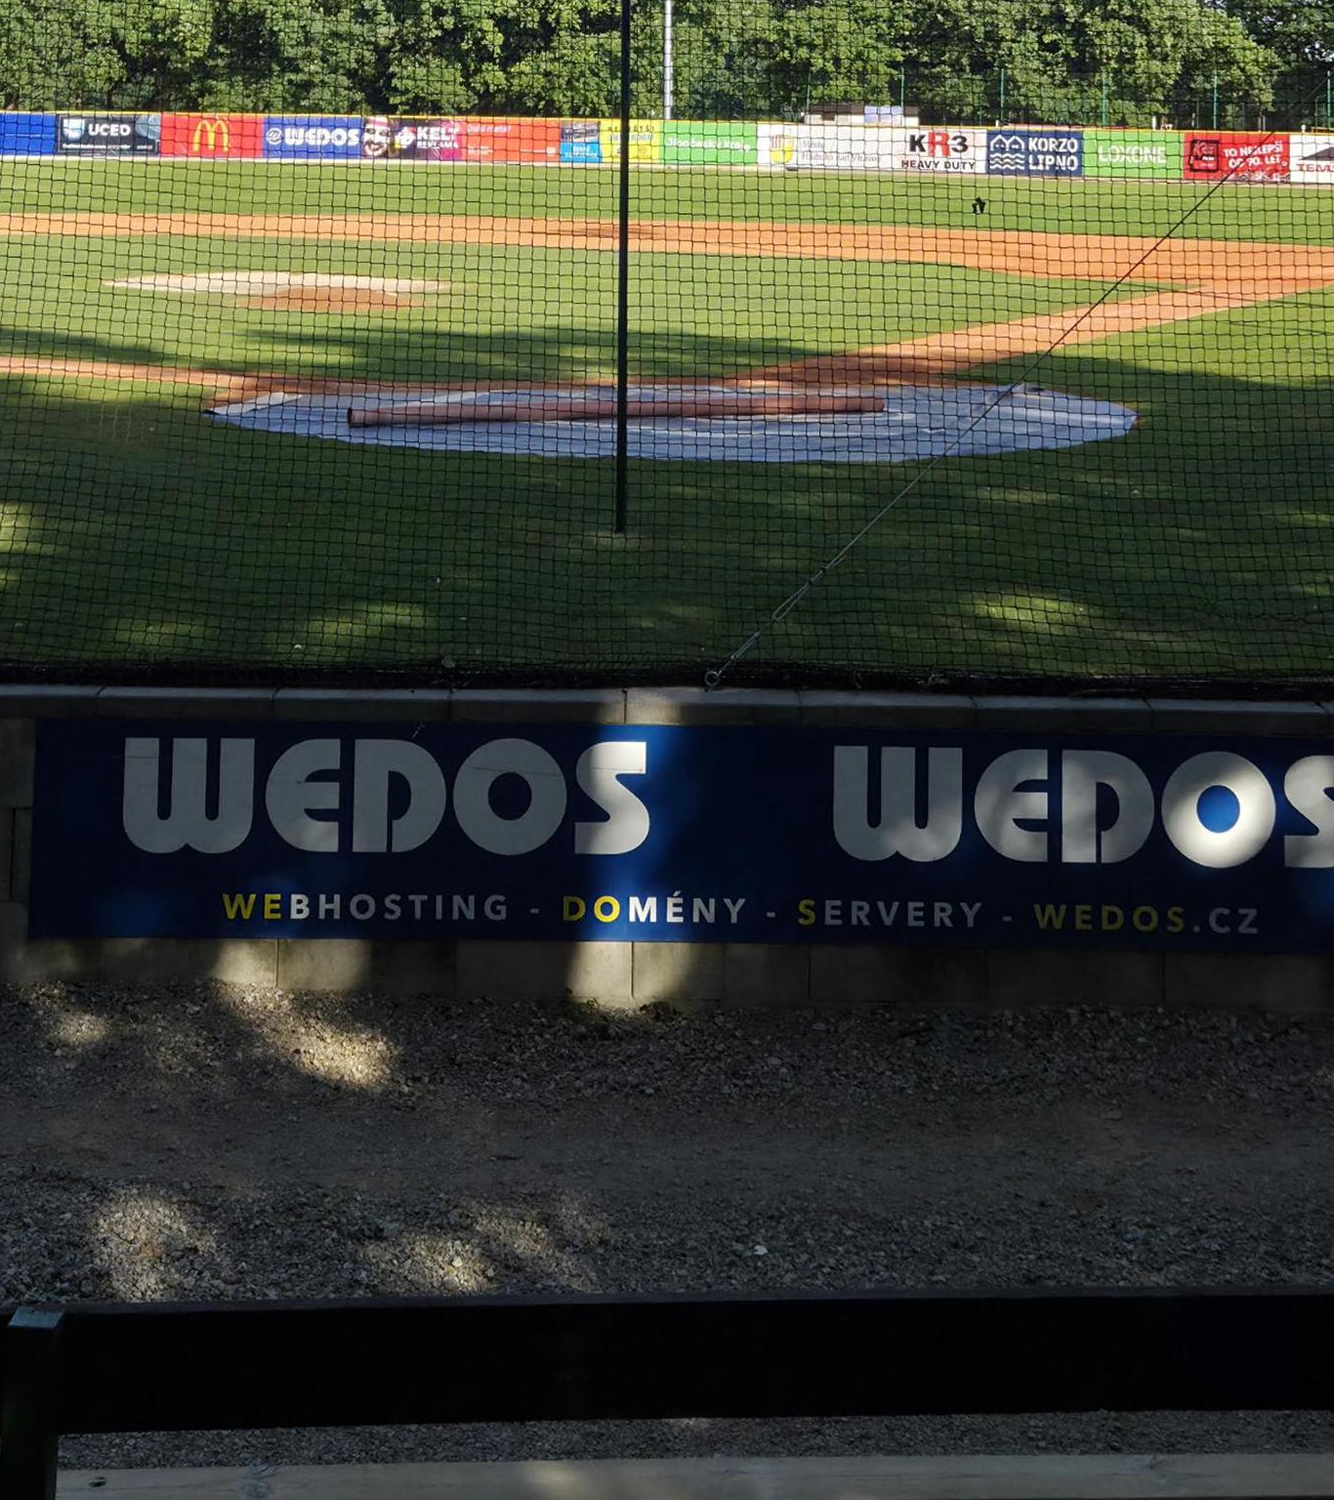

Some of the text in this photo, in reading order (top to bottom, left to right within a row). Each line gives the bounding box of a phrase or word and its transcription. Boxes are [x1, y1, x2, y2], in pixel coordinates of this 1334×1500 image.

[88, 123, 132, 136] UCED
[284, 128, 362, 146] WEDOS
[417, 126, 459, 140] KELT
[909, 132, 969, 158] KR3
[1028, 137, 1078, 152] KORZO
[1224, 148, 1237, 157] TO
[1028, 154, 1078, 171] LIPNO
[1098, 145, 1167, 164] LOXONE
[901, 159, 976, 170] HEAVY DUTY
[123, 737, 650, 856] WEDOS
[222, 893, 508, 922] WEBHOSTING
[562, 891, 746, 924] DOMÉNY
[797, 900, 983, 929] SERVERY
[1034, 903, 1259, 935] WEDOS.CZ
